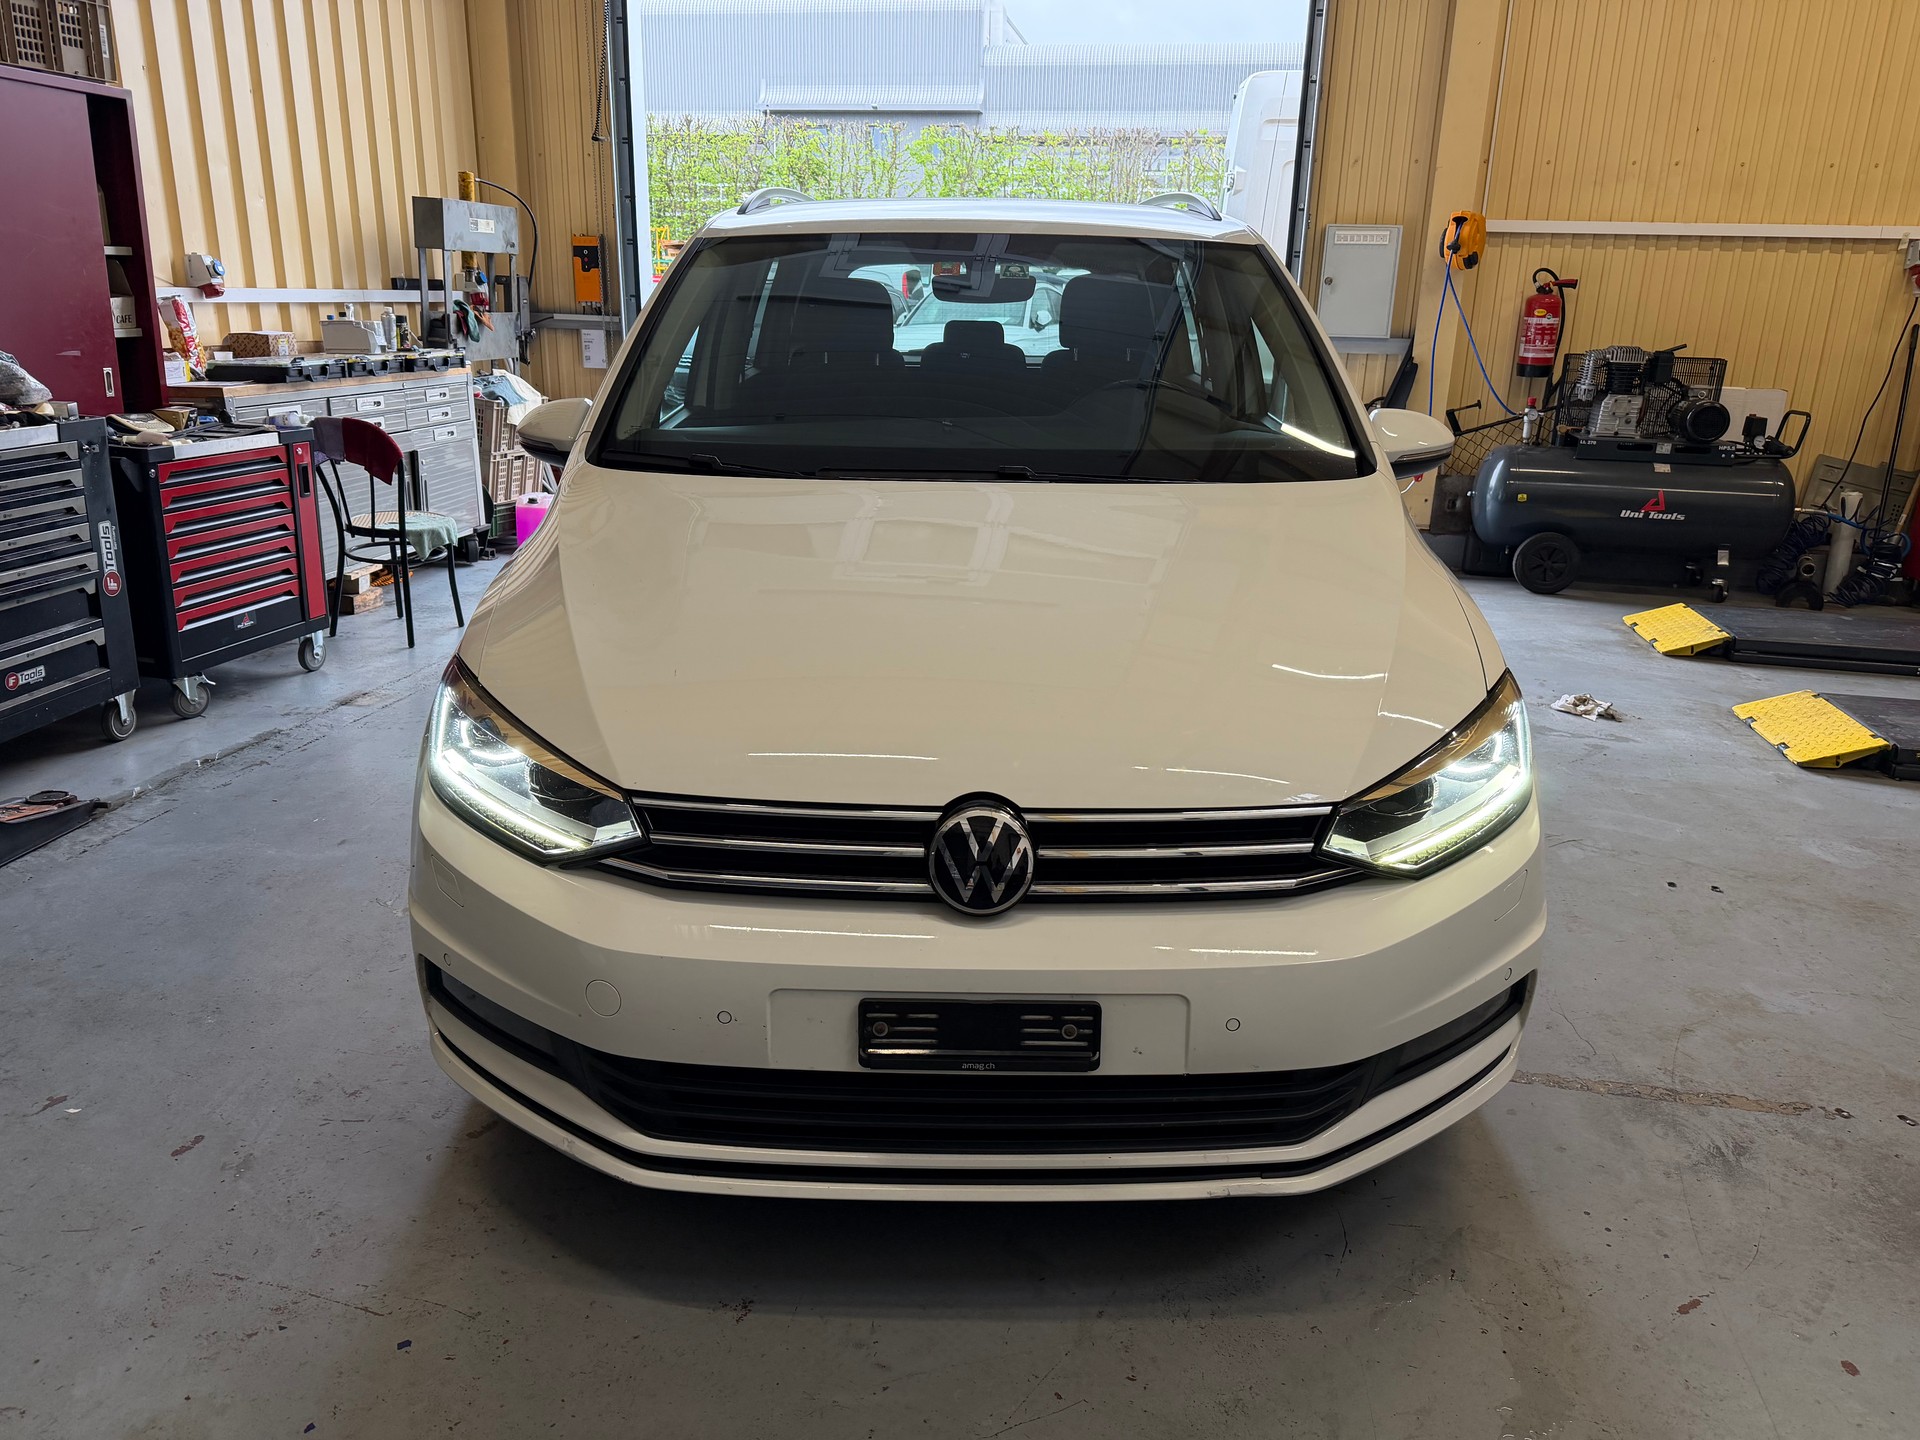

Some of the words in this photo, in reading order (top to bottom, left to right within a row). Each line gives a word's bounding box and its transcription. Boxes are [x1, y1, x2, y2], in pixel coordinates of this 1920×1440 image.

[1620, 509, 1645, 519] Uni
[1648, 511, 1686, 521] Tools
[101, 525, 115, 570] Tools
[20, 667, 43, 682] Tools
[961, 1062, 996, 1071] amag.ch
